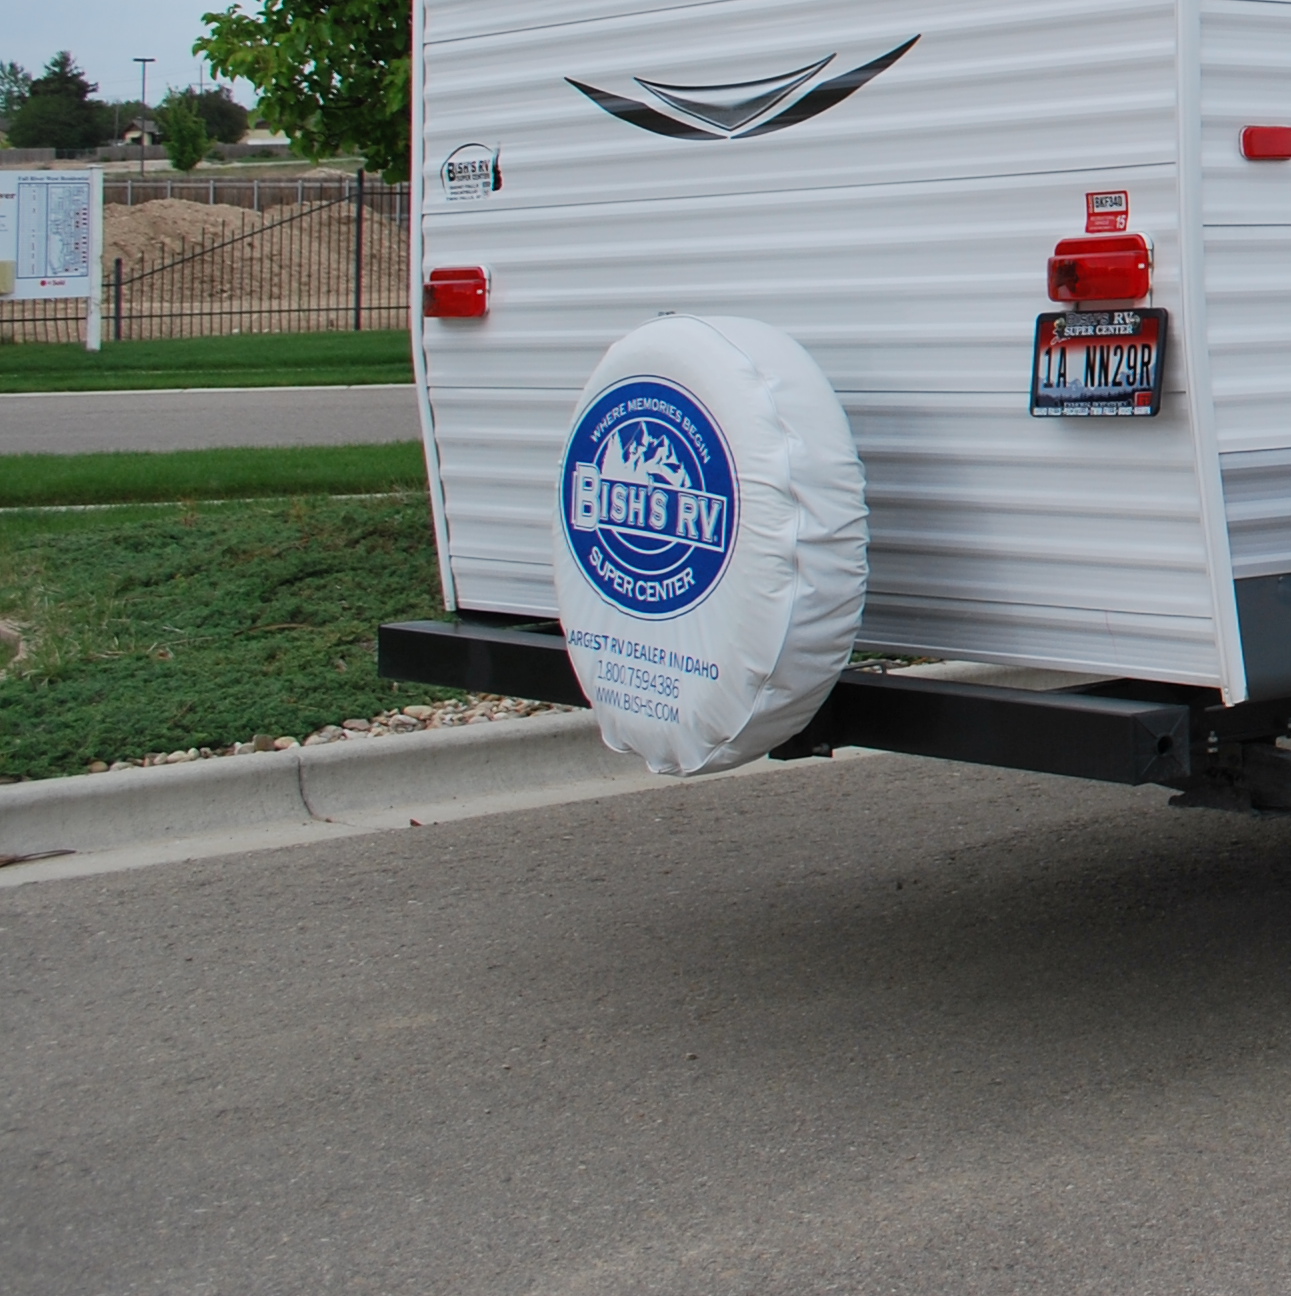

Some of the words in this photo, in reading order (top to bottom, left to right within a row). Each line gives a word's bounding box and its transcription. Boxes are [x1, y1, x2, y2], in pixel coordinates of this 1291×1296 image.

[1064, 325, 1094, 336] SUPER
[1095, 325, 1133, 335] CENTER
[1113, 312, 1135, 324] RV
[1043, 345, 1067, 388] 1A
[1084, 343, 1152, 388] NN29R
[590, 405, 627, 443] WHERE
[627, 398, 683, 423] MEMORIES
[681, 416, 711, 464] BEGIN
[571, 461, 668, 532] BISH'S
[676, 492, 722, 542] RV
[589, 546, 634, 598] SUPER
[634, 567, 696, 602] CENTER
[566, 628, 609, 651] LARGEST
[611, 638, 625, 655] RV
[626, 641, 667, 666] DEALER
[595, 685, 680, 724] WWW.BISHS.COM
